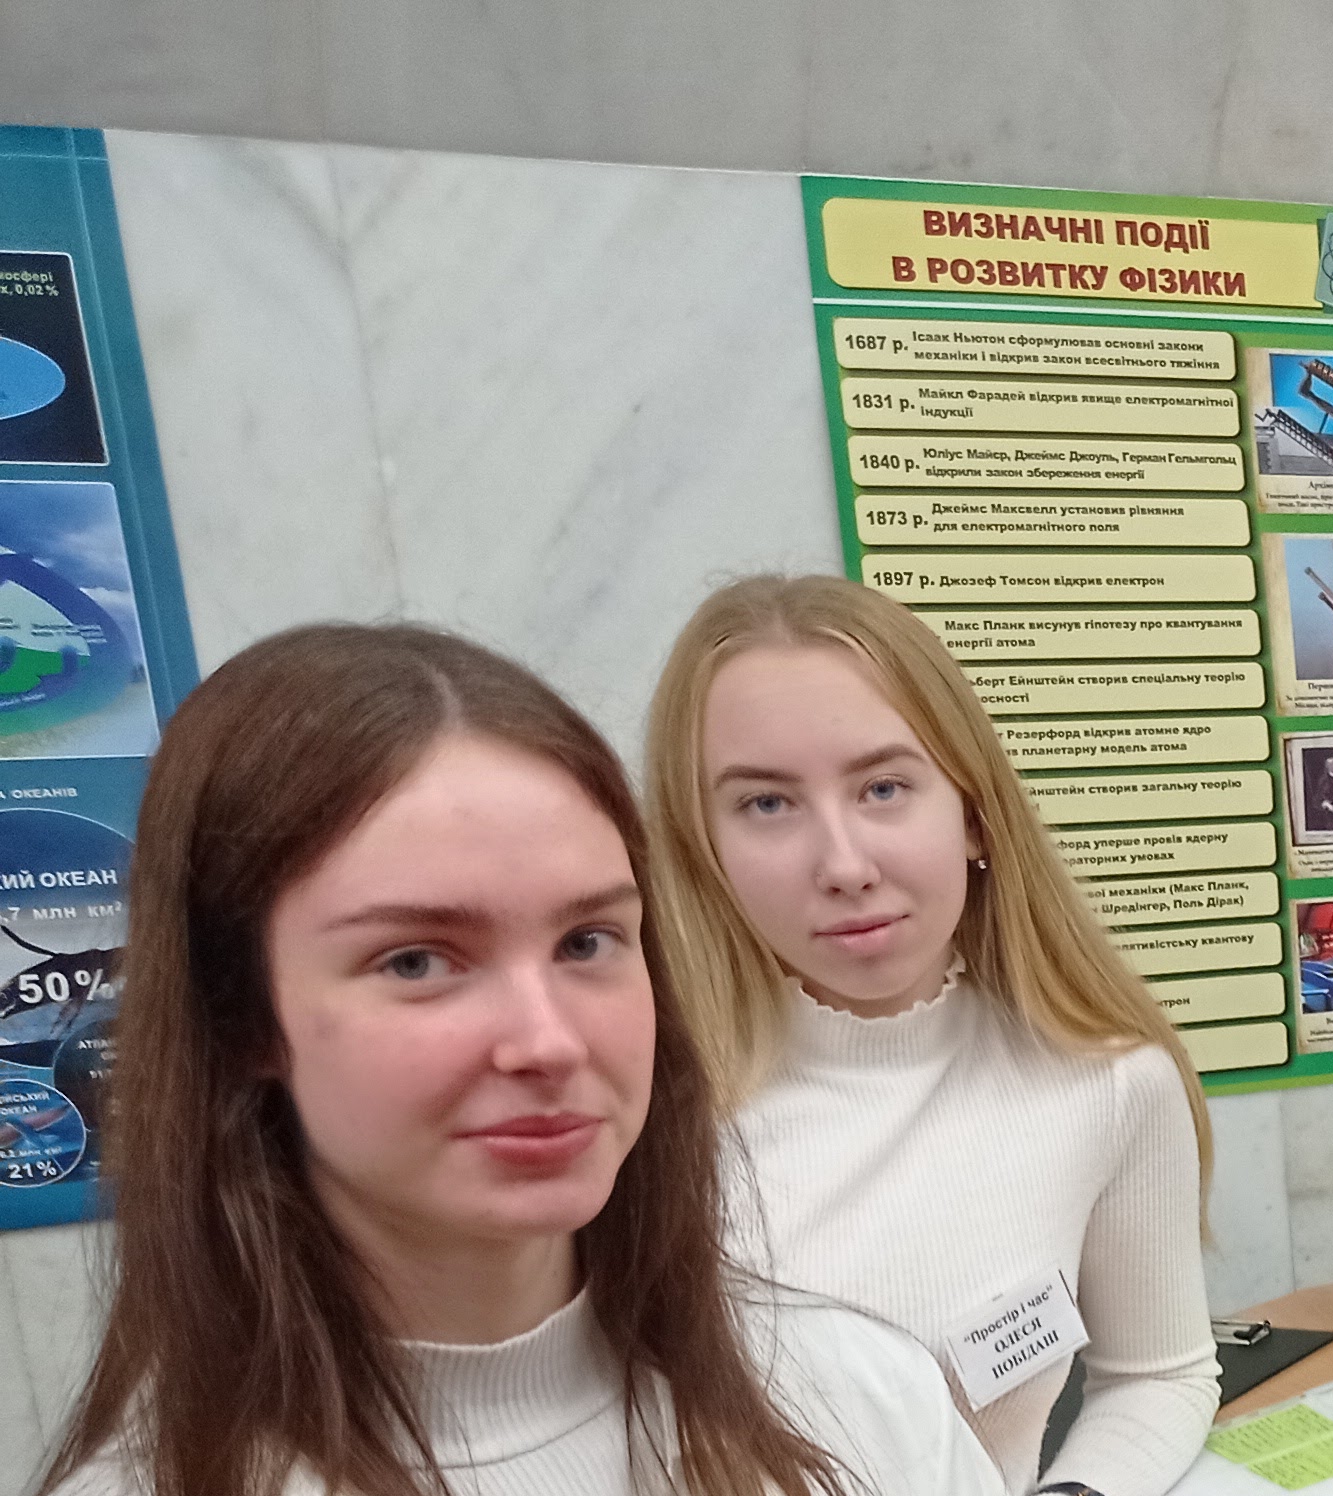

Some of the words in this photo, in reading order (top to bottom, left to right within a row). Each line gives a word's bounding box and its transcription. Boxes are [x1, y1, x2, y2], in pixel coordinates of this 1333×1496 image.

[923, 208, 1105, 246] ВИЗНАЧНІ
[1115, 220, 1211, 253] ПОДІЇ
[891, 256, 917, 284] В
[927, 257, 1108, 293] РОЗВИТКУ
[1120, 265, 1247, 298] ФІЗИКИ
[845, 334, 886, 351] 1687
[892, 338, 909, 353] р.
[913, 331, 950, 344] Ісаак
[953, 331, 1006, 346] Ньютон
[1008, 334, 1102, 351] сформулював
[1105, 339, 1155, 351] основні
[1158, 341, 1204, 352] закони
[914, 349, 979, 363] механіки
[989, 351, 1040, 366] відкрив
[1043, 355, 1082, 365] закон
[1085, 355, 1167, 369] всесвітнього
[1169, 360, 1220, 370] тяжіння
[852, 394, 894, 410] 1831
[918, 388, 964, 401] Майкл
[967, 389, 1026, 404] Фарадей
[1029, 390, 1079, 404] відкрив
[1081, 395, 1123, 406] явище
[859, 454, 900, 470] 1840
[922, 448, 964, 462] Юліус
[1014, 450, 1066, 463] Джеймс
[1123, 452, 1167, 465] Герман
[985, 467, 1024, 478] закон
[866, 510, 908, 527] 1873
[932, 503, 988, 517] Джеймс
[991, 503, 1057, 516] Максвелл
[1060, 505, 1127, 518] установив
[1129, 505, 1184, 518] рівняння
[933, 521, 958, 533] для
[961, 520, 1087, 536] електромагнітного
[1089, 522, 1120, 533] поля
[873, 571, 914, 587] 1897
[919, 574, 935, 590] р.
[939, 574, 997, 589] Джозеф
[1000, 575, 1051, 587] Томсон
[1054, 574, 1104, 588] відкрив
[1106, 575, 1165, 588] електрон
[945, 620, 980, 632] Макс
[983, 619, 1026, 631] Планк
[1028, 618, 1082, 632] висунув
[1084, 618, 1138, 632] гіпотезу
[1140, 619, 1163, 631] про
[1166, 618, 1243, 631] квантування
[946, 636, 993, 651] енергії
[996, 637, 1036, 648] атома
[1008, 672, 1075, 687] Ейнштейн
[1078, 673, 1128, 686] створив
[1204, 671, 1245, 684] теорію
[1007, 726, 1081, 741] Резерфорд
[1083, 725, 1132, 739] відкрив
[1135, 725, 1180, 737] атомне
[1182, 724, 1212, 737] ядро
[1021, 746, 1098, 759] планетарну
[1100, 742, 1147, 755] модель
[1150, 741, 1188, 752] атома
[11, 787, 78, 799] ОКЕАНІВ
[1028, 785, 1085, 797] йнштейн
[1088, 784, 1138, 794] створив
[1142, 782, 1197, 793] загальну
[1201, 779, 1242, 790] теорію
[1093, 837, 1140, 850] уперше
[1143, 835, 1182, 846] провів
[1186, 832, 1228, 844] ядерну
[1130, 851, 1175, 864] умовах
[39, 869, 118, 887] ОКЕАН
[1109, 885, 1166, 897] механіки
[1173, 898, 1204, 909] Поль
[1201, 934, 1254, 946] квантову
[994, 1317, 1042, 1353] ОЛЕСЯ
